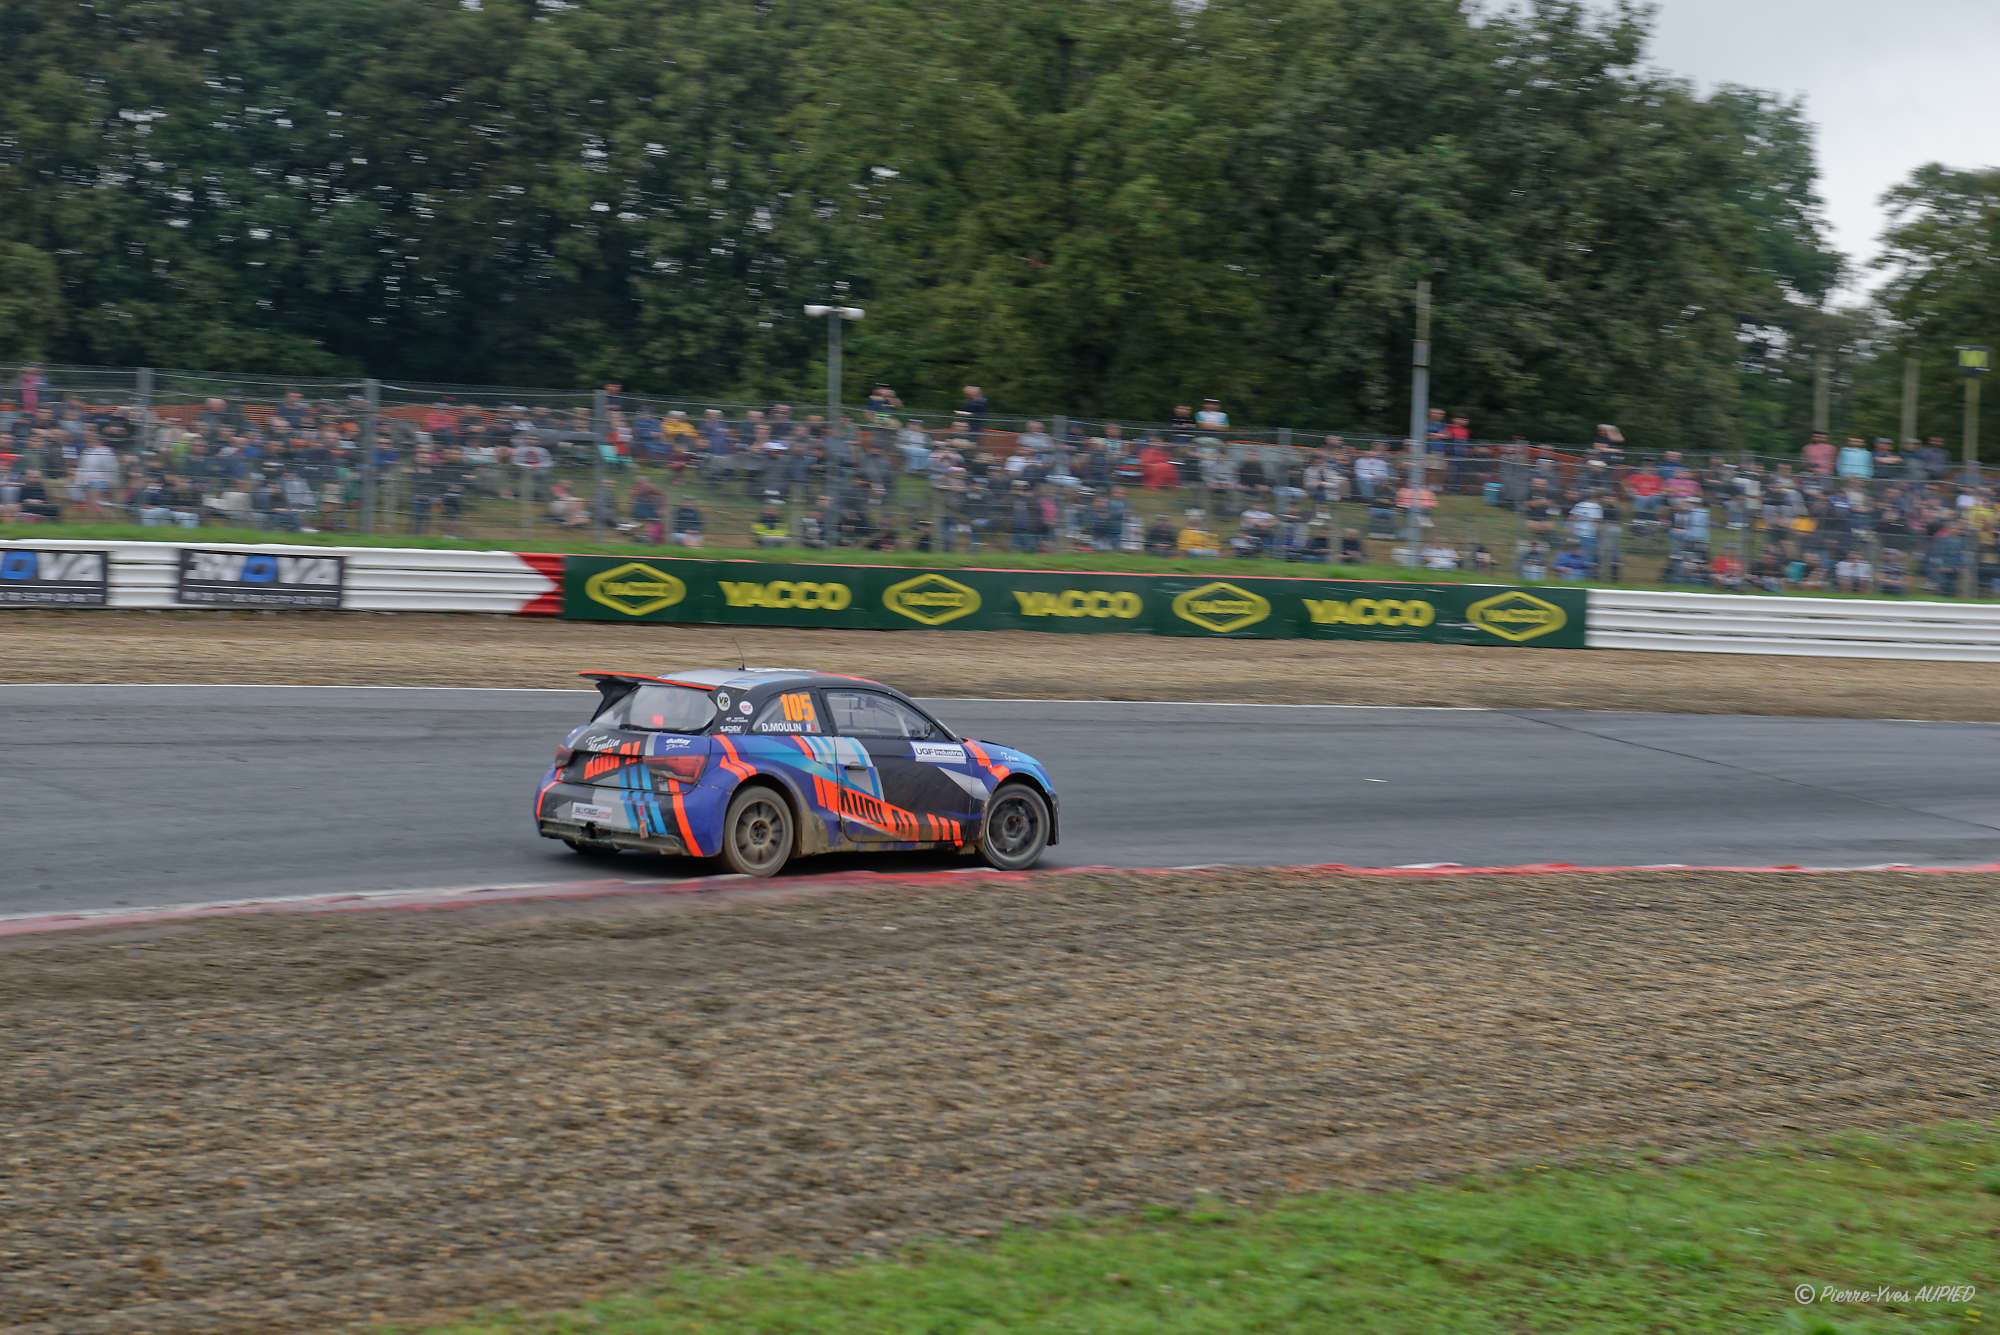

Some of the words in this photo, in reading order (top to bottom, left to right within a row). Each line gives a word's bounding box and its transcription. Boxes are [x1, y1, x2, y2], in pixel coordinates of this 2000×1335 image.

[719, 581, 851, 610] YACCO
[1013, 591, 1142, 619] YACCO
[1303, 599, 1434, 627] YACCO
[780, 693, 815, 721] 105
[762, 723, 801, 732] D.MOULIN
[916, 747, 934, 756] UGF
[840, 787, 888, 827] AUDI
